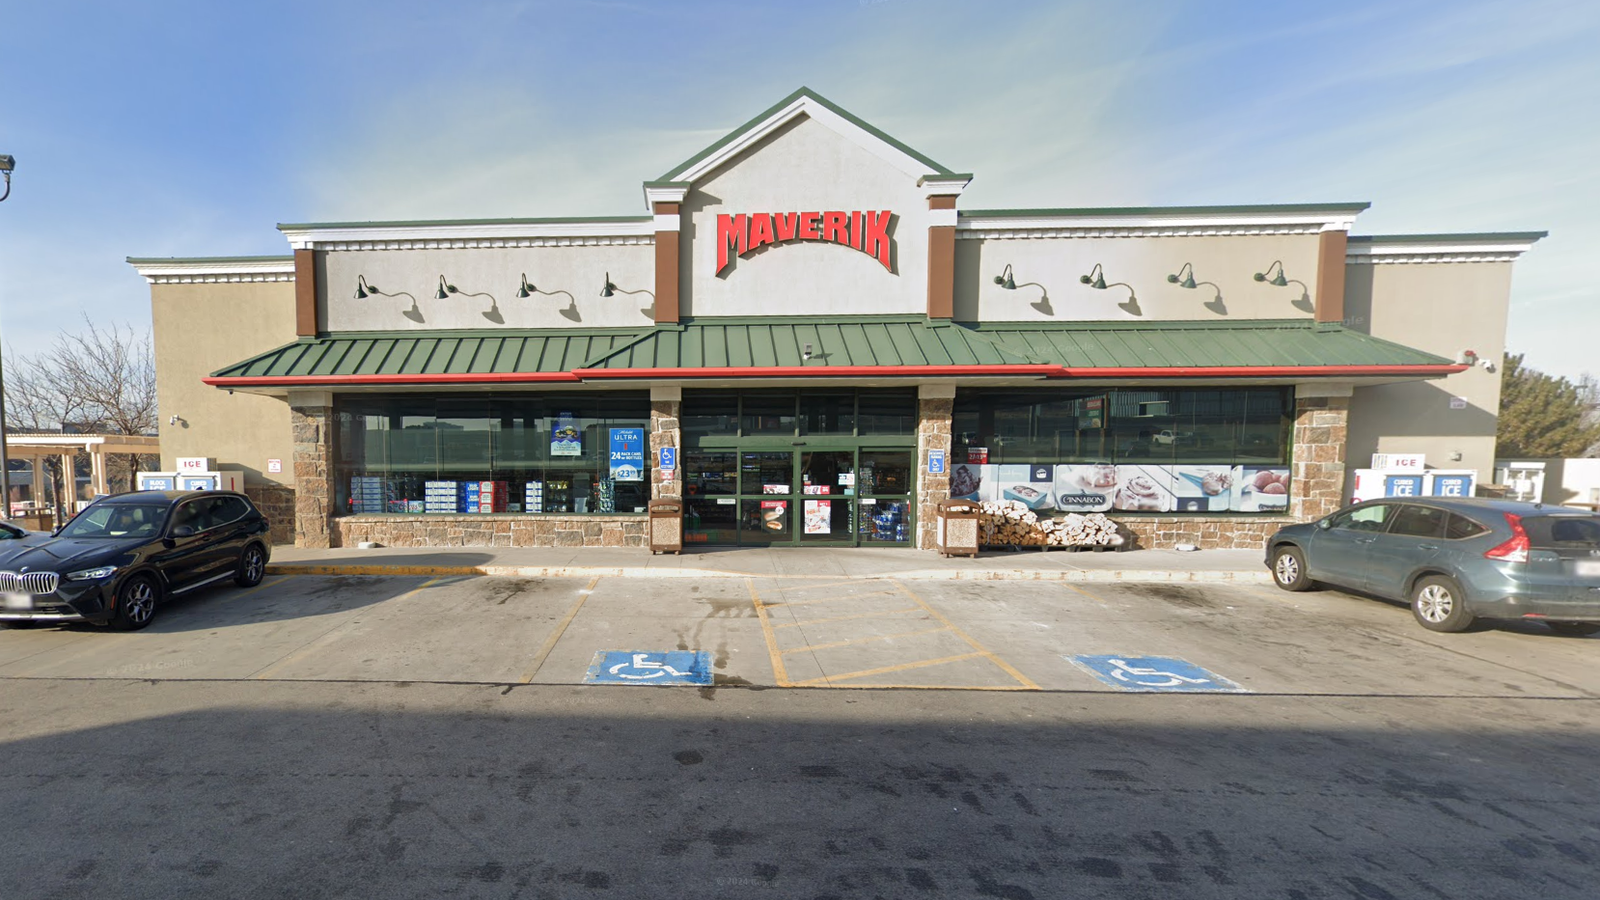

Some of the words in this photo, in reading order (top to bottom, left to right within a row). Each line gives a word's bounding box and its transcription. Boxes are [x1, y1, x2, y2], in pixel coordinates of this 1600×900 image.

[715, 210, 892, 275] MAVERIK
[611, 451, 621, 460] 24
[1392, 485, 1413, 497] ICE
[1441, 485, 1462, 497] ICE
[1062, 495, 1104, 504] CINNABON
